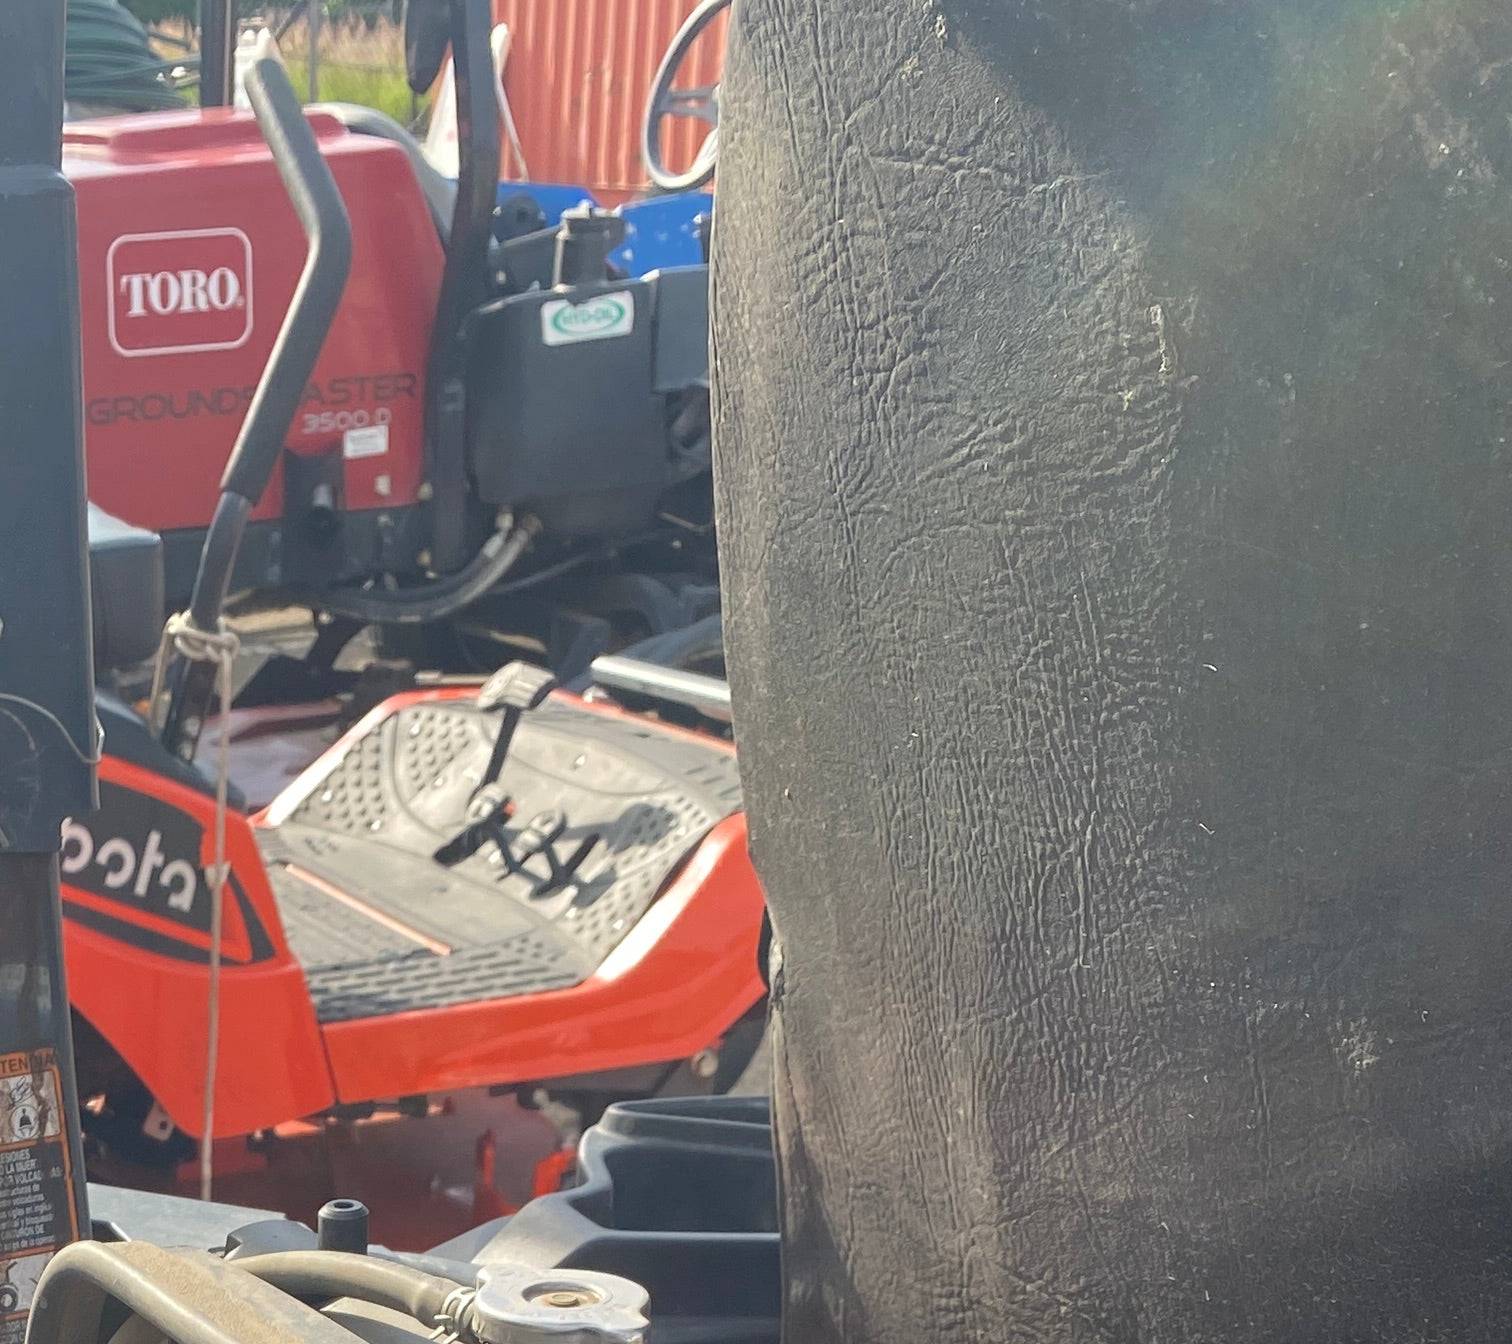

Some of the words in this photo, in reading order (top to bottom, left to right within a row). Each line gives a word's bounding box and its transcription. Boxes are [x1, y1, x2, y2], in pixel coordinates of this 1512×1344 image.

[120, 267, 241, 318] TORO
[302, 410, 369, 434] 3500
[61, 816, 197, 913] bota
